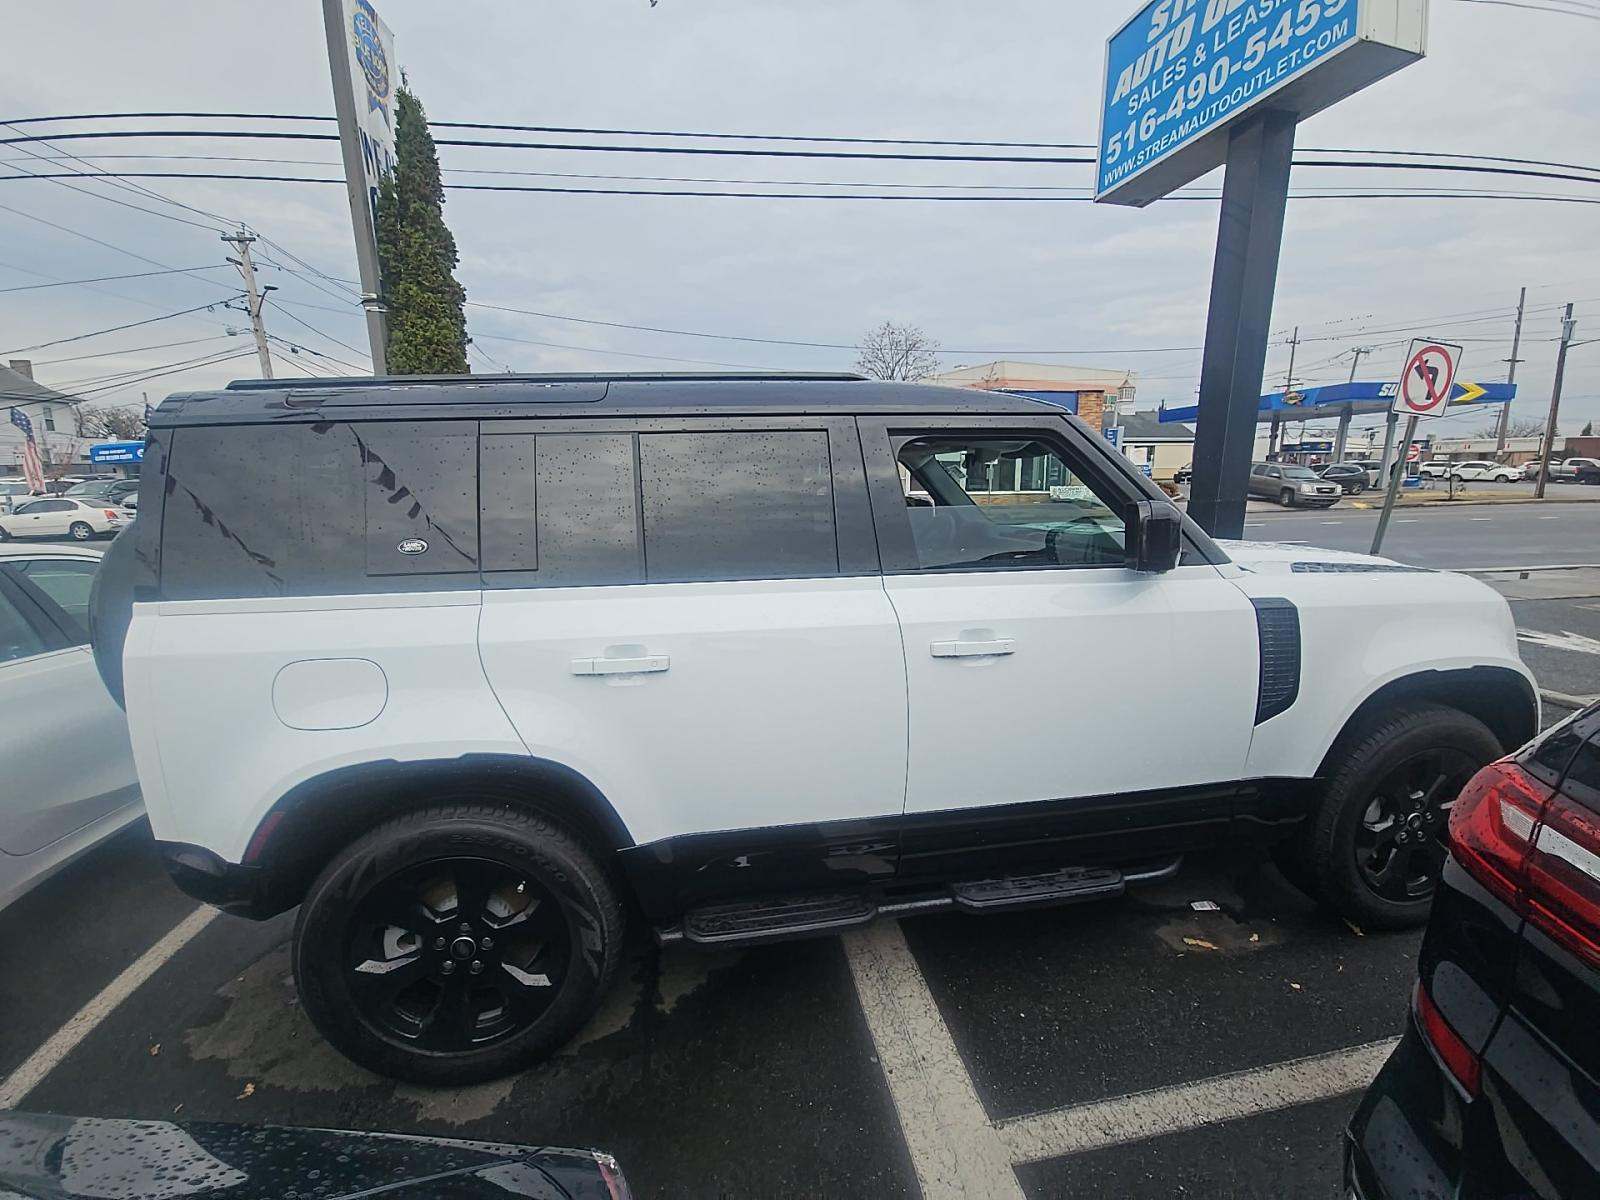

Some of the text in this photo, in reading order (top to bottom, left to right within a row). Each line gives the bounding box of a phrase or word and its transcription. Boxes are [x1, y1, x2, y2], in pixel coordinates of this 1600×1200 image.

[1103, 18, 1349, 187] WWW.STREAMAUTOOUTLET.COM
[1110, 12, 1197, 107] AUTO
[1127, 0, 1286, 116] SALES & LEAS
